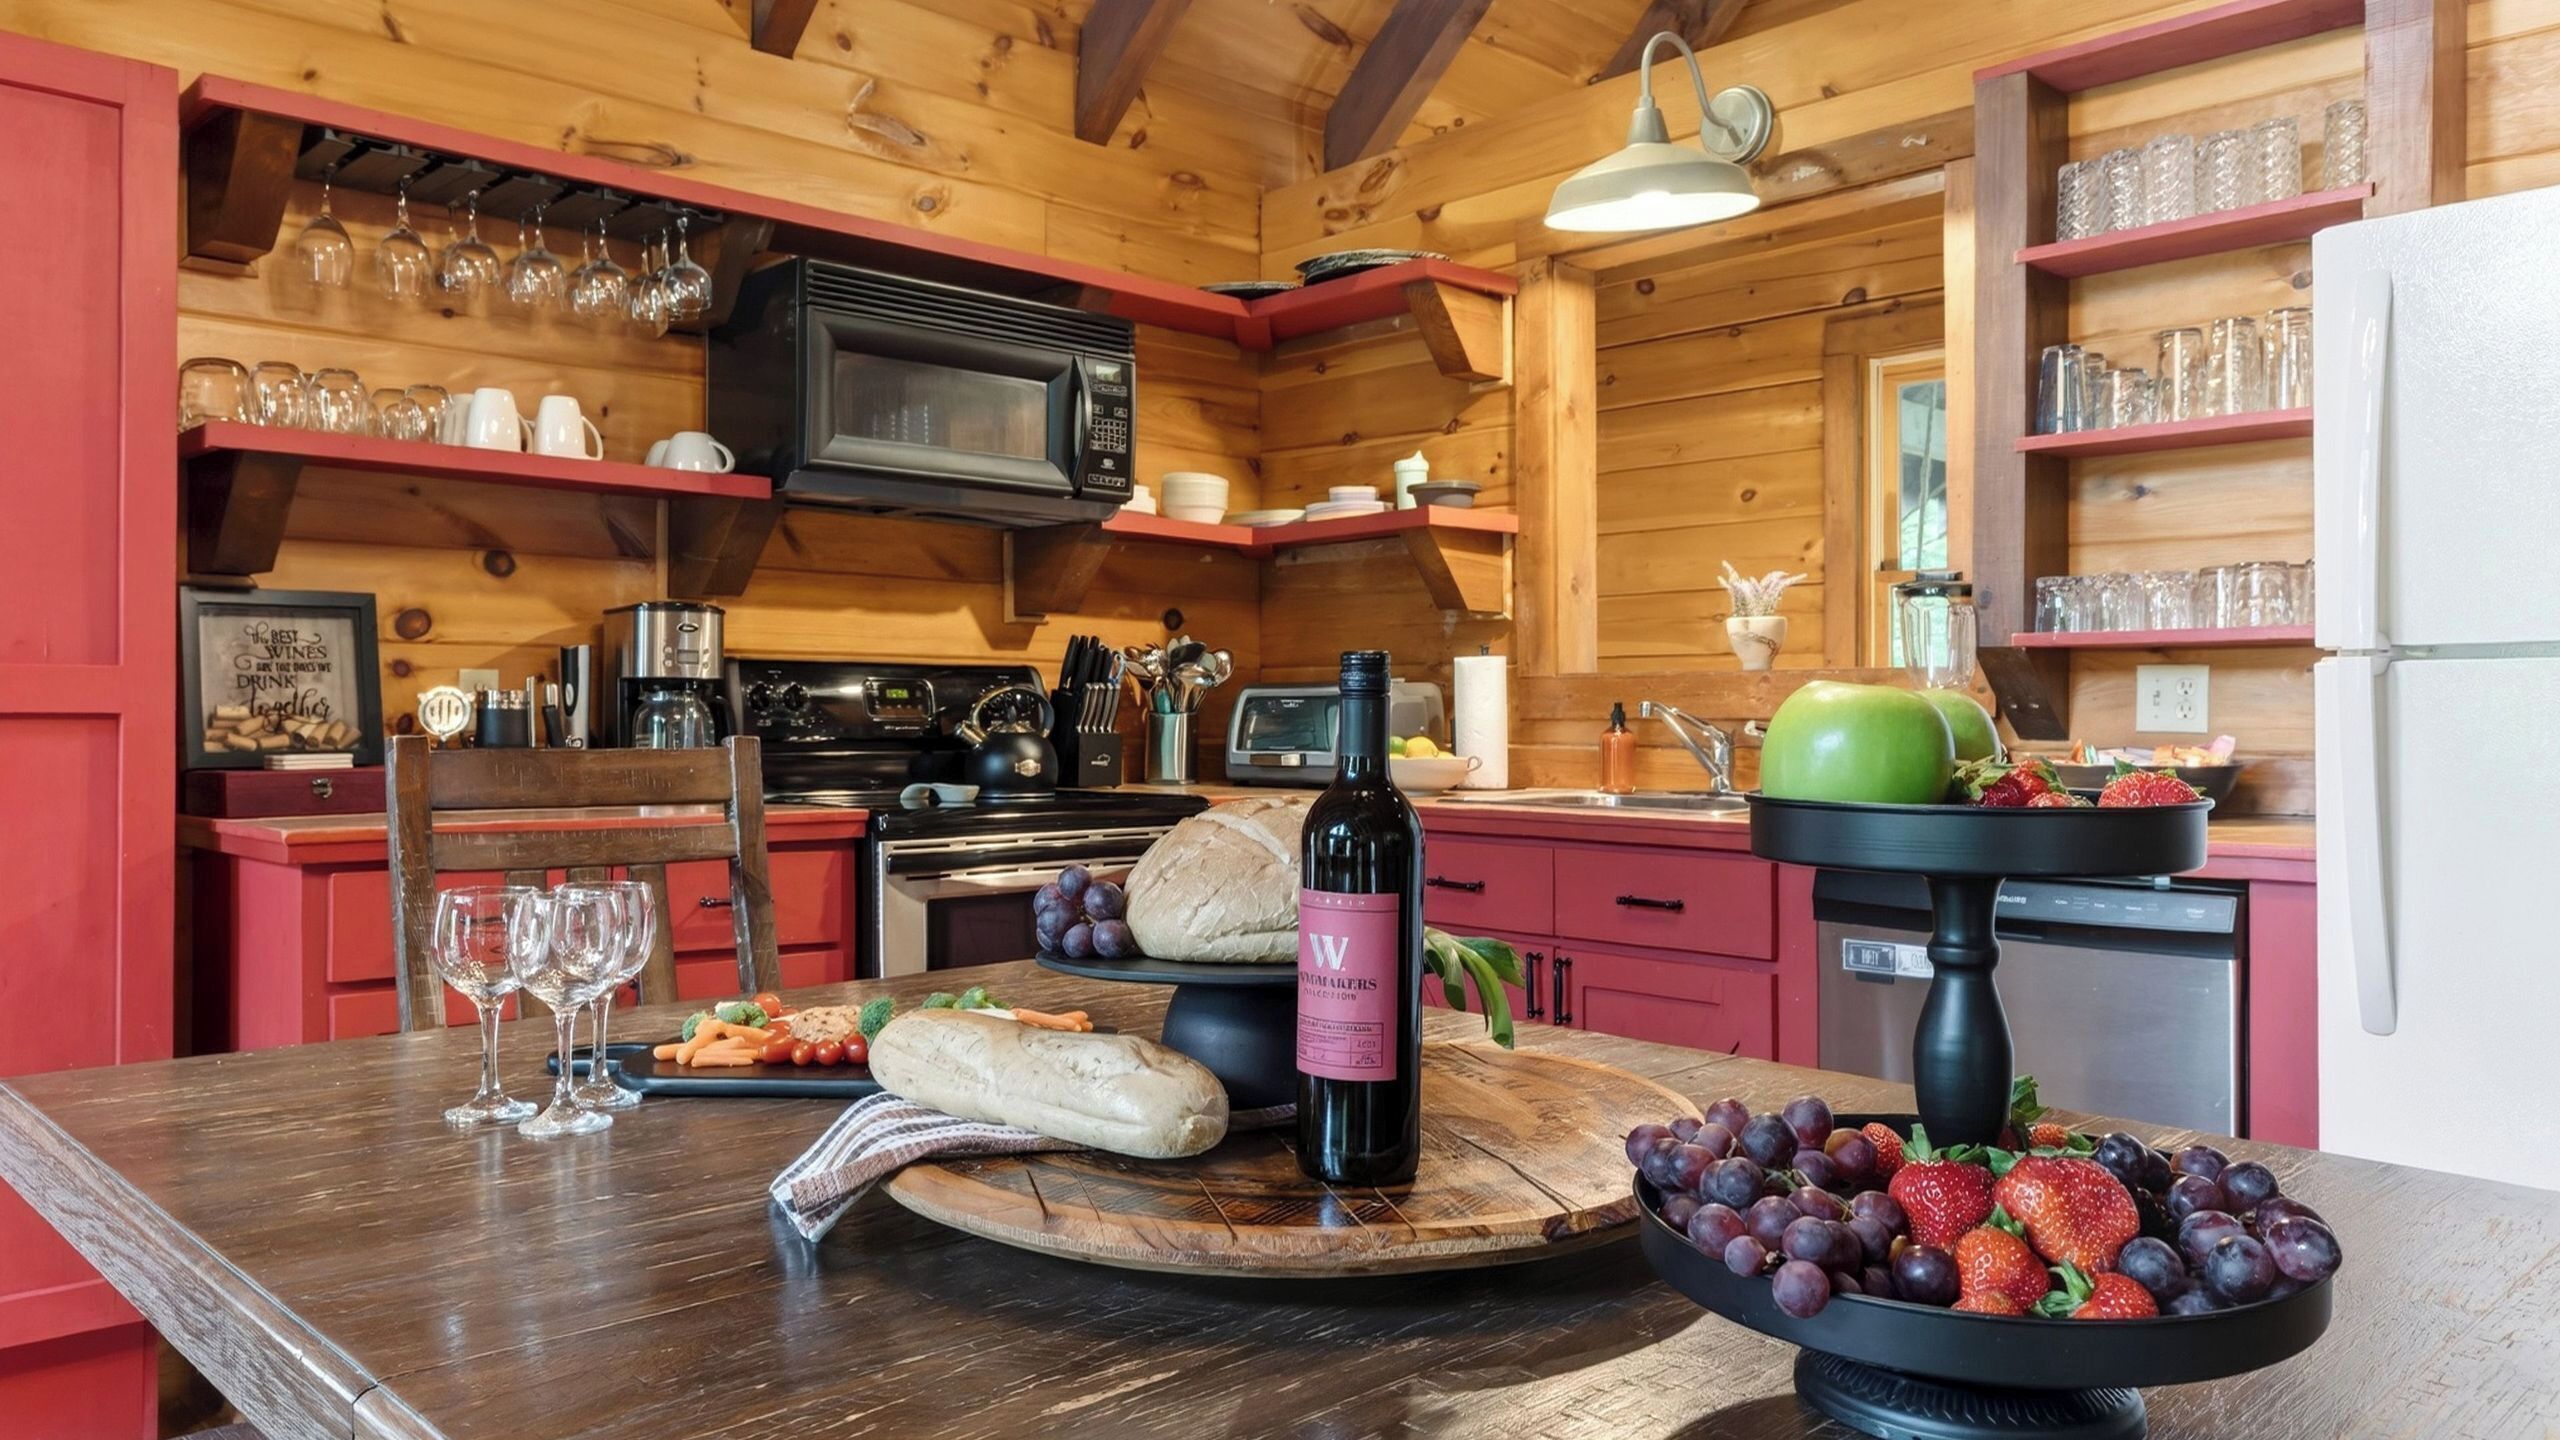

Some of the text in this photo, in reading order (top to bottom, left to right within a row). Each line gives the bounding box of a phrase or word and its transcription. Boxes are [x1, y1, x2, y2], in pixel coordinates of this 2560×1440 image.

[271, 629, 298, 645] BEST
[264, 645, 328, 660] WINES
[236, 674, 296, 691] DRINK
